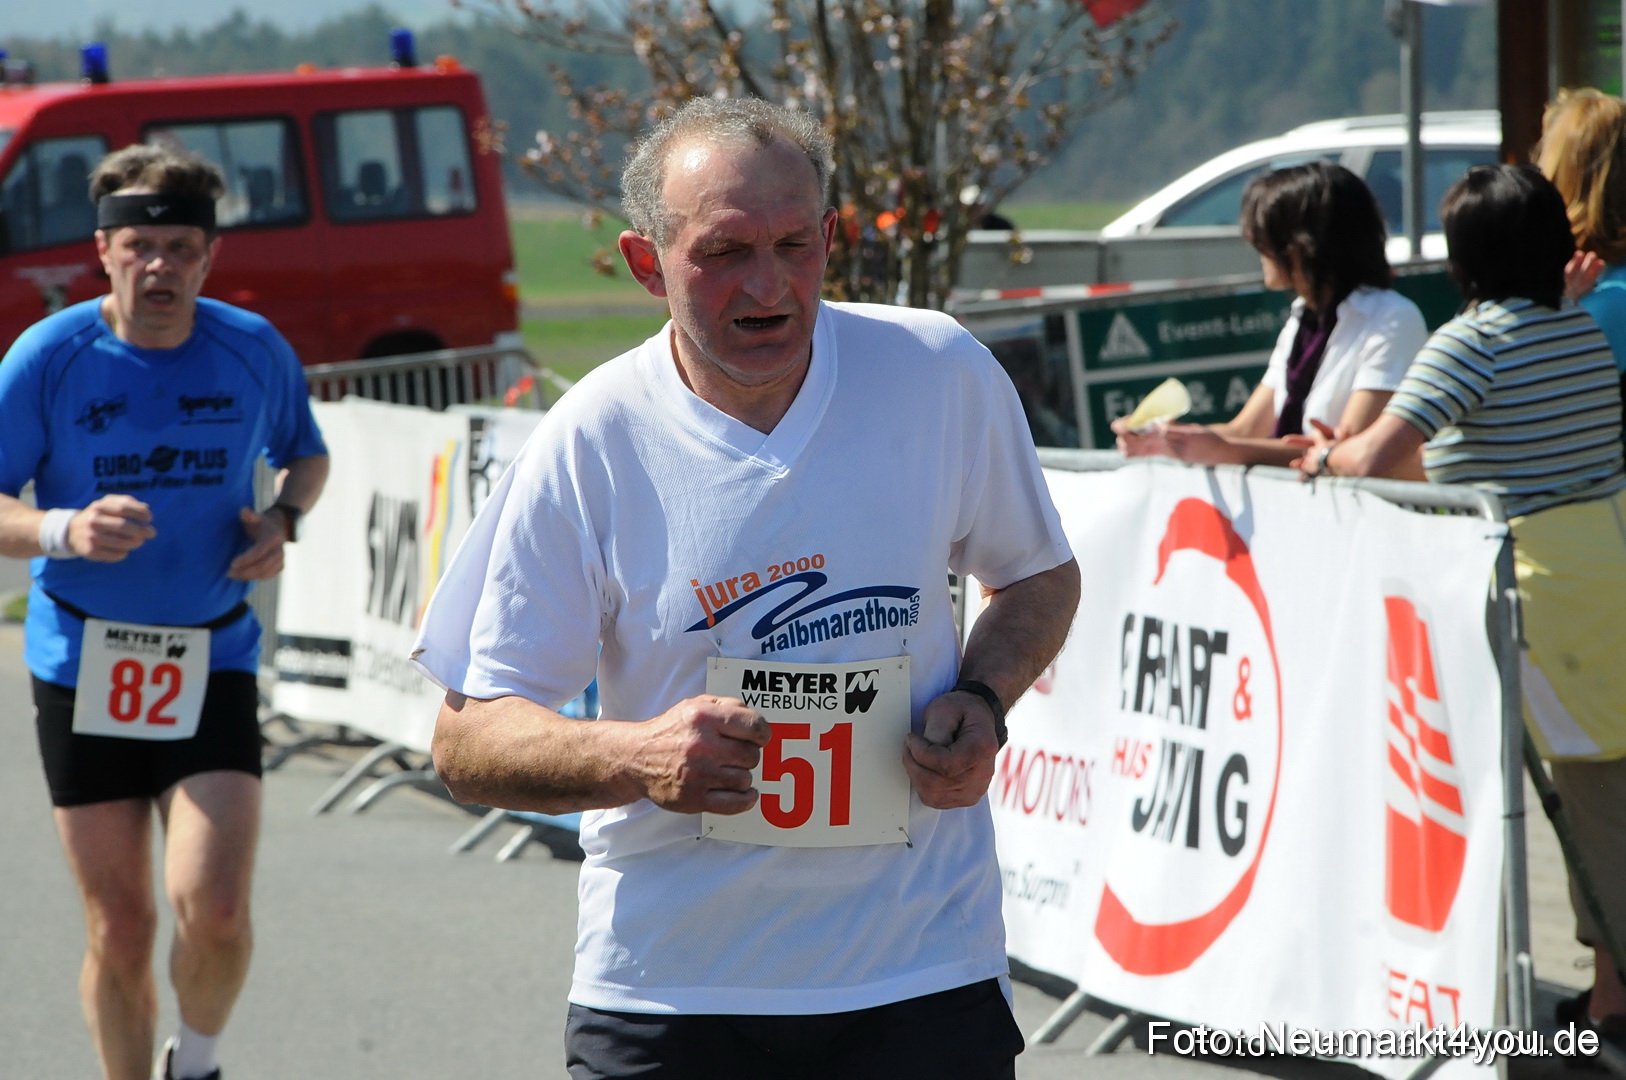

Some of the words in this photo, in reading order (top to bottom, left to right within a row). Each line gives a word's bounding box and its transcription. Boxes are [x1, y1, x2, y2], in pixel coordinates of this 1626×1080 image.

[93, 453, 142, 478] EURO
[182, 448, 228, 470] PLUS
[689, 570, 762, 628] jura
[766, 553, 826, 583] 2000
[907, 594, 921, 627] 2005
[760, 598, 909, 655] Halbmarathon
[108, 658, 183, 725] 82
[741, 669, 838, 694] MEYER
[741, 691, 839, 710] WERBUNG
[760, 721, 853, 829] 51
[993, 746, 1095, 826] MOTORS
